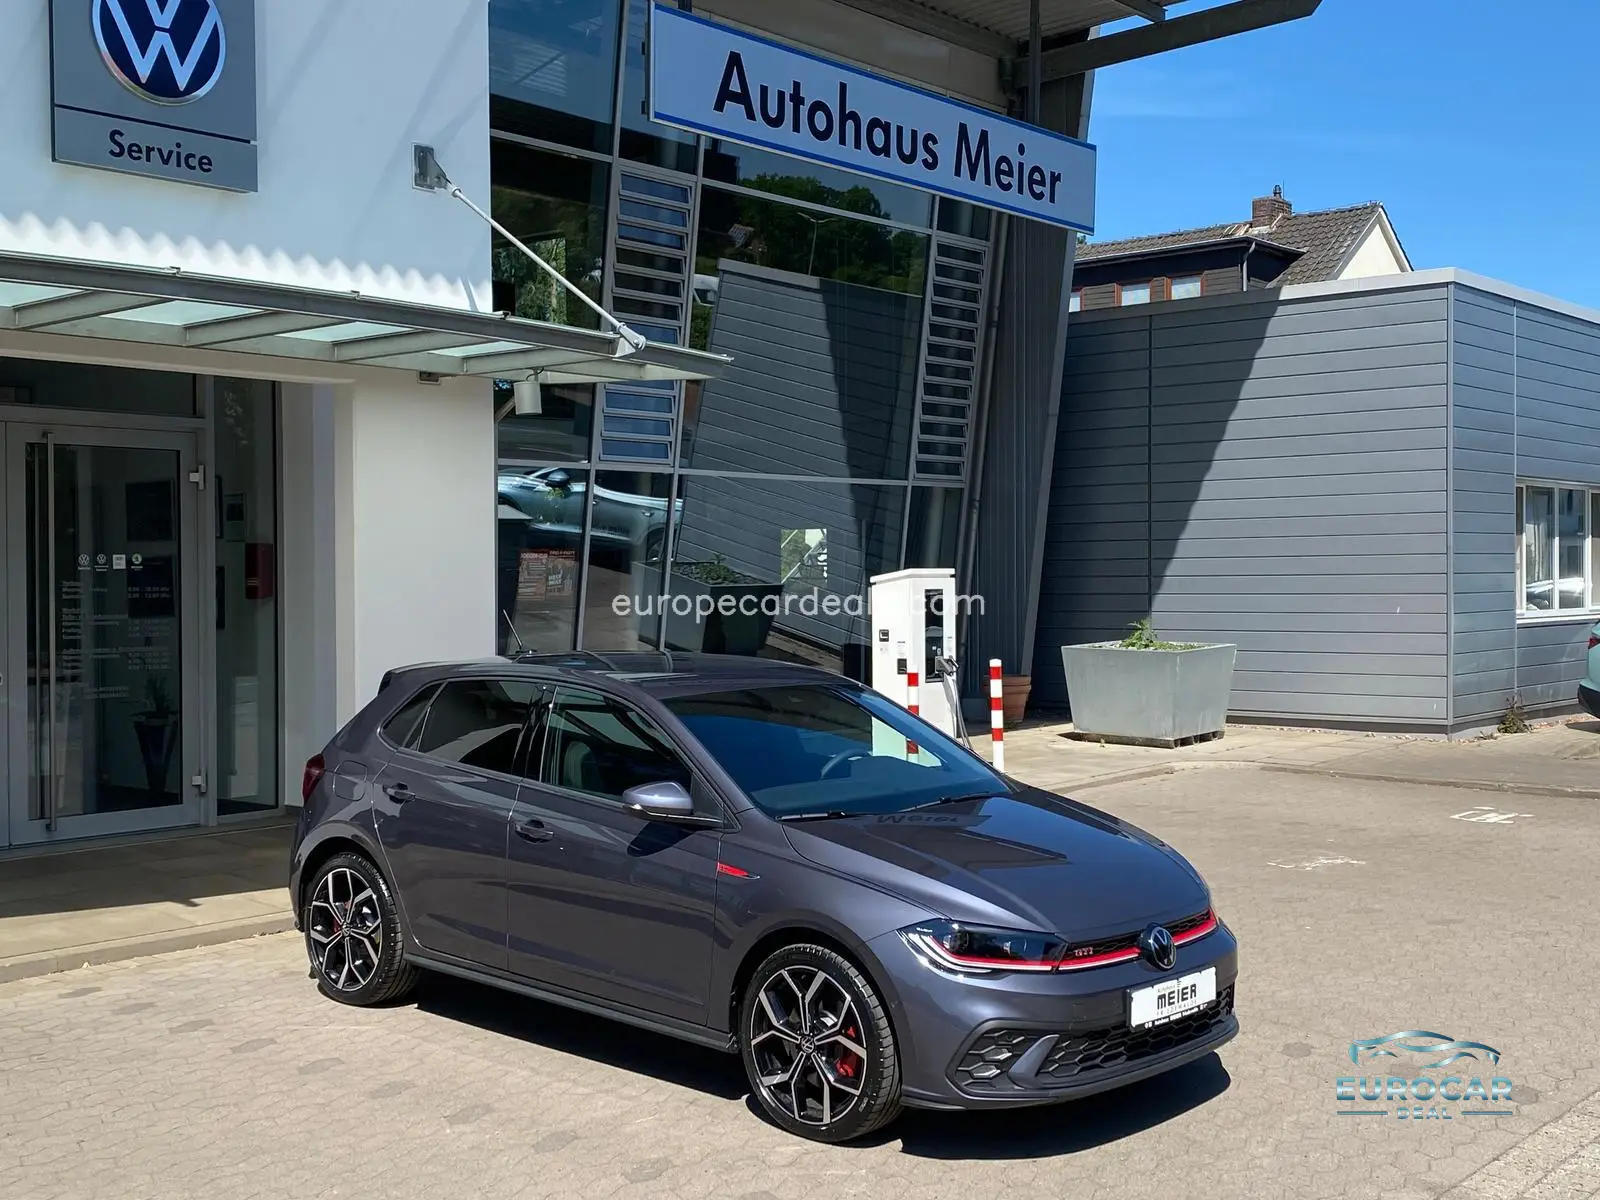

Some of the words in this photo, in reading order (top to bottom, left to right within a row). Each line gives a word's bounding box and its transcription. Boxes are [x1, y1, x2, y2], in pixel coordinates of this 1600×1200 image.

[713, 50, 939, 171] Autohaus
[953, 121, 1063, 204] Meier
[108, 129, 214, 173] Service
[1157, 983, 1198, 1010] MEIER
